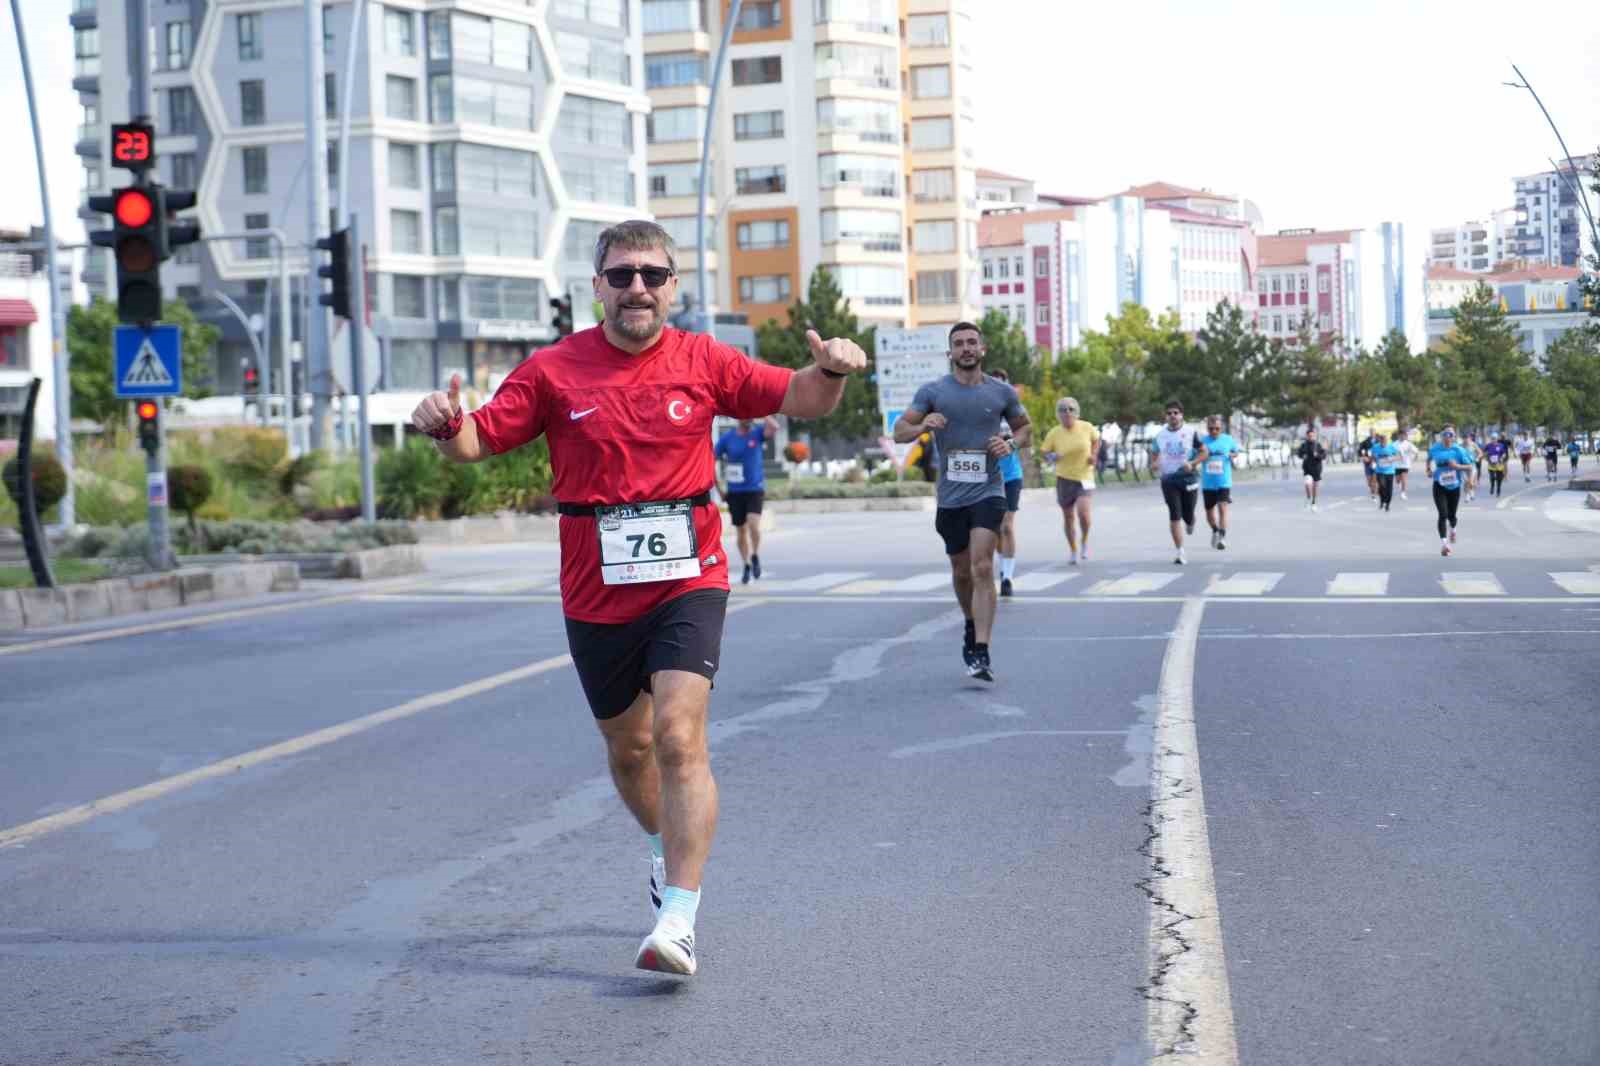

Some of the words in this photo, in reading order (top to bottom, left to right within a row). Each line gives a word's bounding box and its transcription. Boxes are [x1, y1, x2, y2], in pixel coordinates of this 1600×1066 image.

[115, 132, 149, 160] 23
[953, 461, 980, 471] 556
[626, 533, 667, 557] 76
